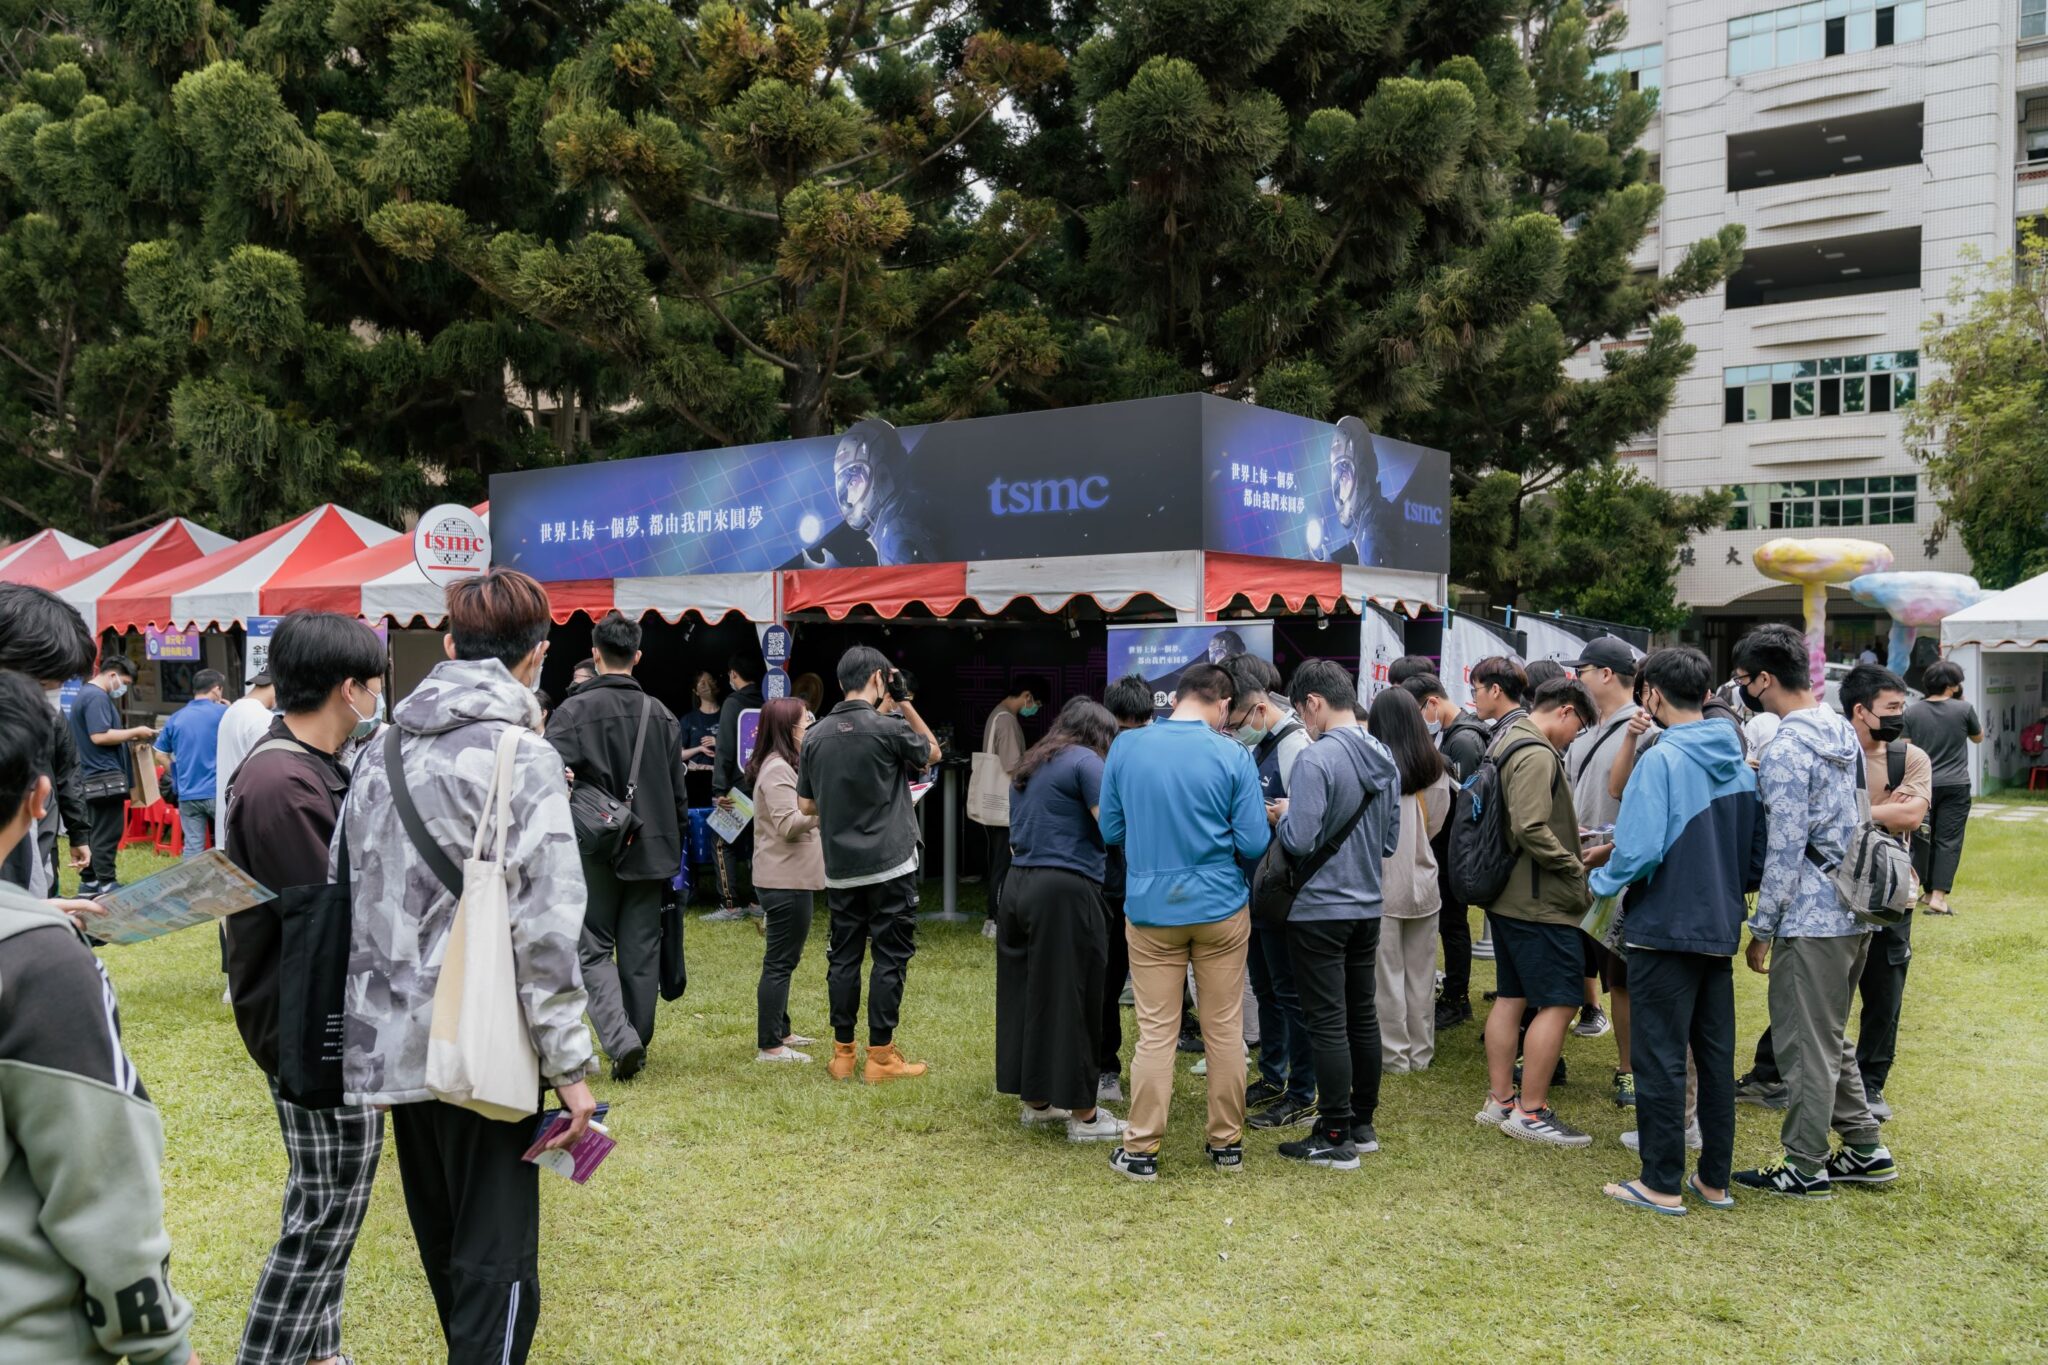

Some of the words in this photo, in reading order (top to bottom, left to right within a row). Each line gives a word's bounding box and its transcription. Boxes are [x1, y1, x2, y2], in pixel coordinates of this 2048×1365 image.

[987, 475, 1110, 515] tsmc
[1404, 500, 1443, 526] tsmc
[424, 531, 485, 552] tsmc
